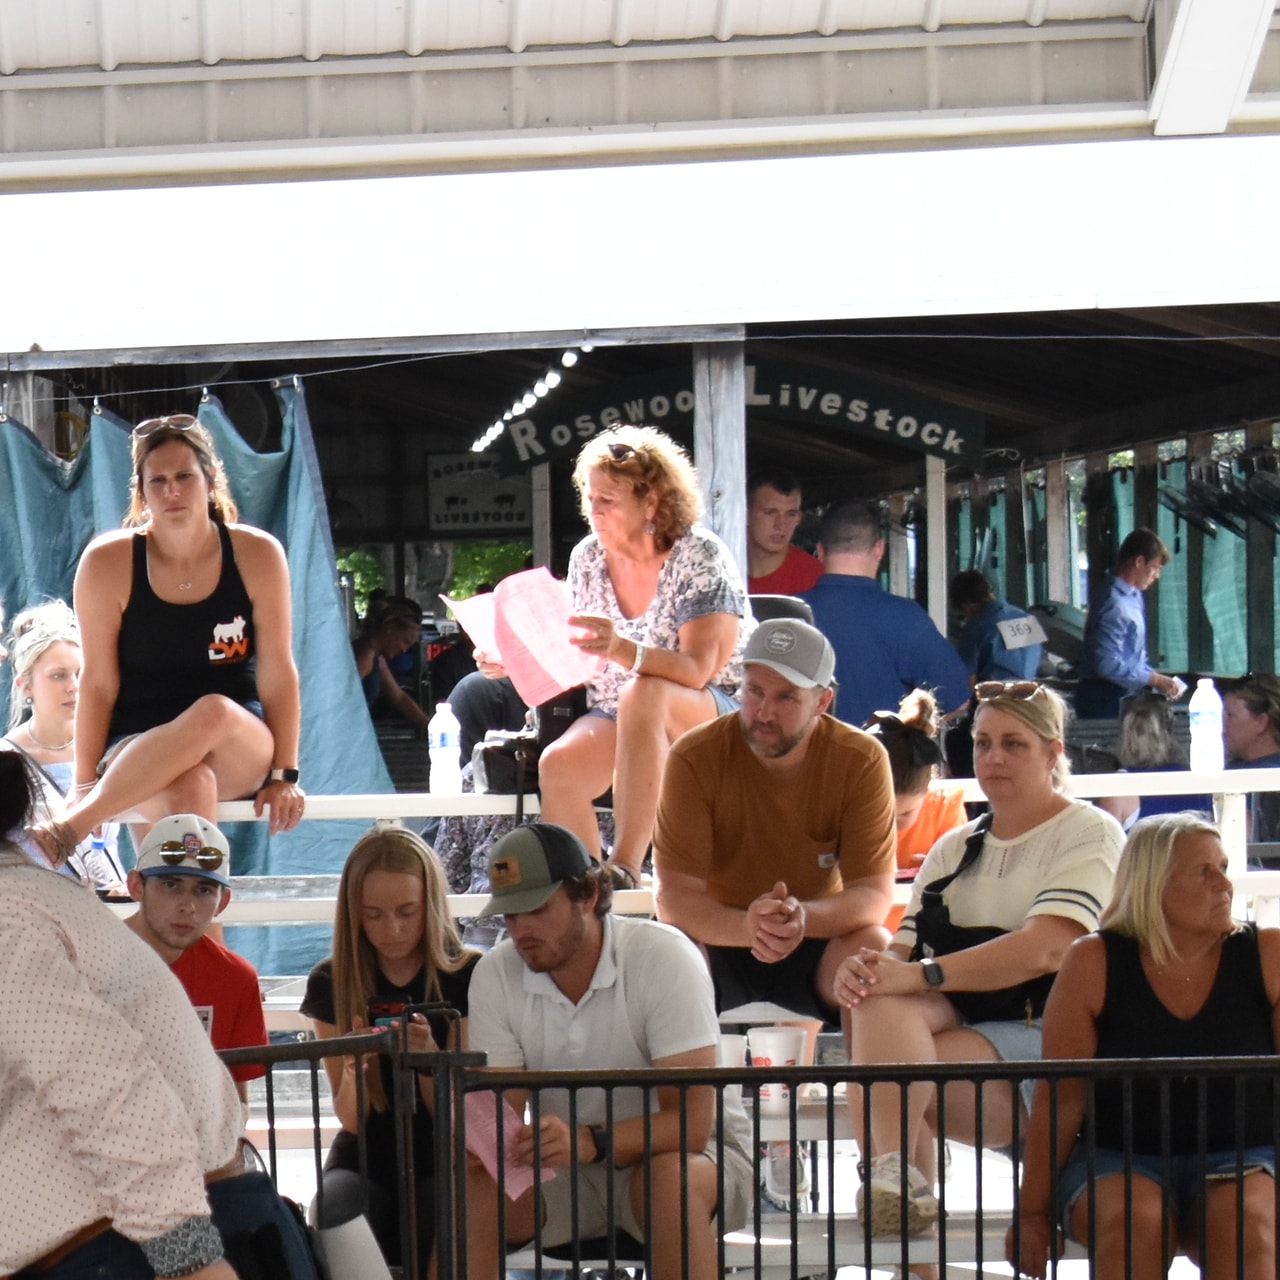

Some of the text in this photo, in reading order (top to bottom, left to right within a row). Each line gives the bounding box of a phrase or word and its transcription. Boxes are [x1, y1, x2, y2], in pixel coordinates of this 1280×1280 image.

[509, 365, 965, 462] Rosewoo Livestock
[435, 511, 526, 524] LIVESTOCK
[1007, 623, 1033, 637] 369
